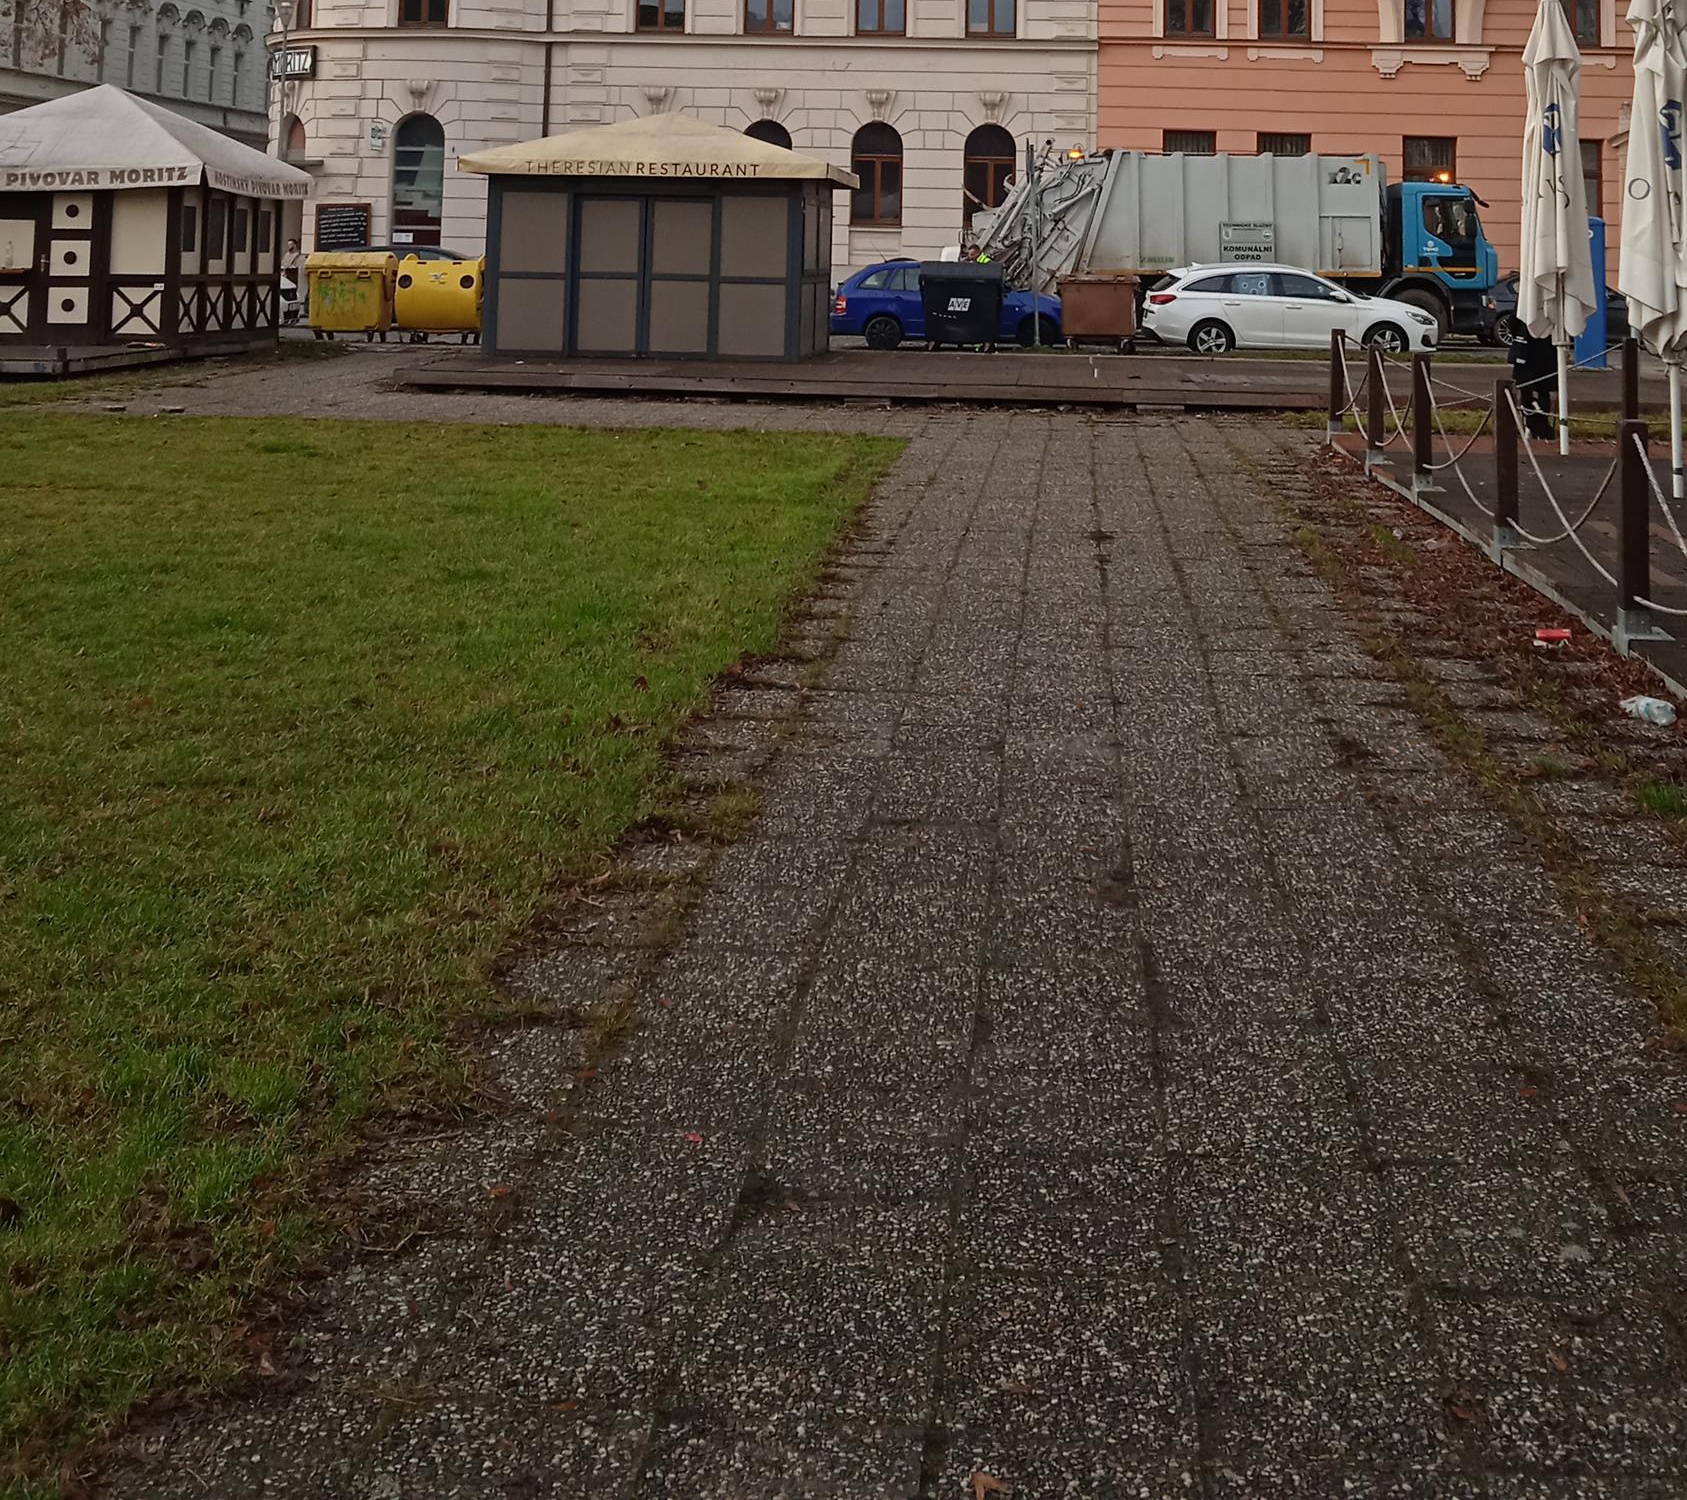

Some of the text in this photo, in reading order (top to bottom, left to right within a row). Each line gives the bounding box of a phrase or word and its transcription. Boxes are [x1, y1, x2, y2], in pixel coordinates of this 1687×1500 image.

[273, 51, 310, 73] MRITZ
[5, 166, 188, 187] PIVOVAR MORITZ
[525, 161, 760, 177] THERESIAN RESTAURANT
[1234, 253, 1262, 261] ODPAD
